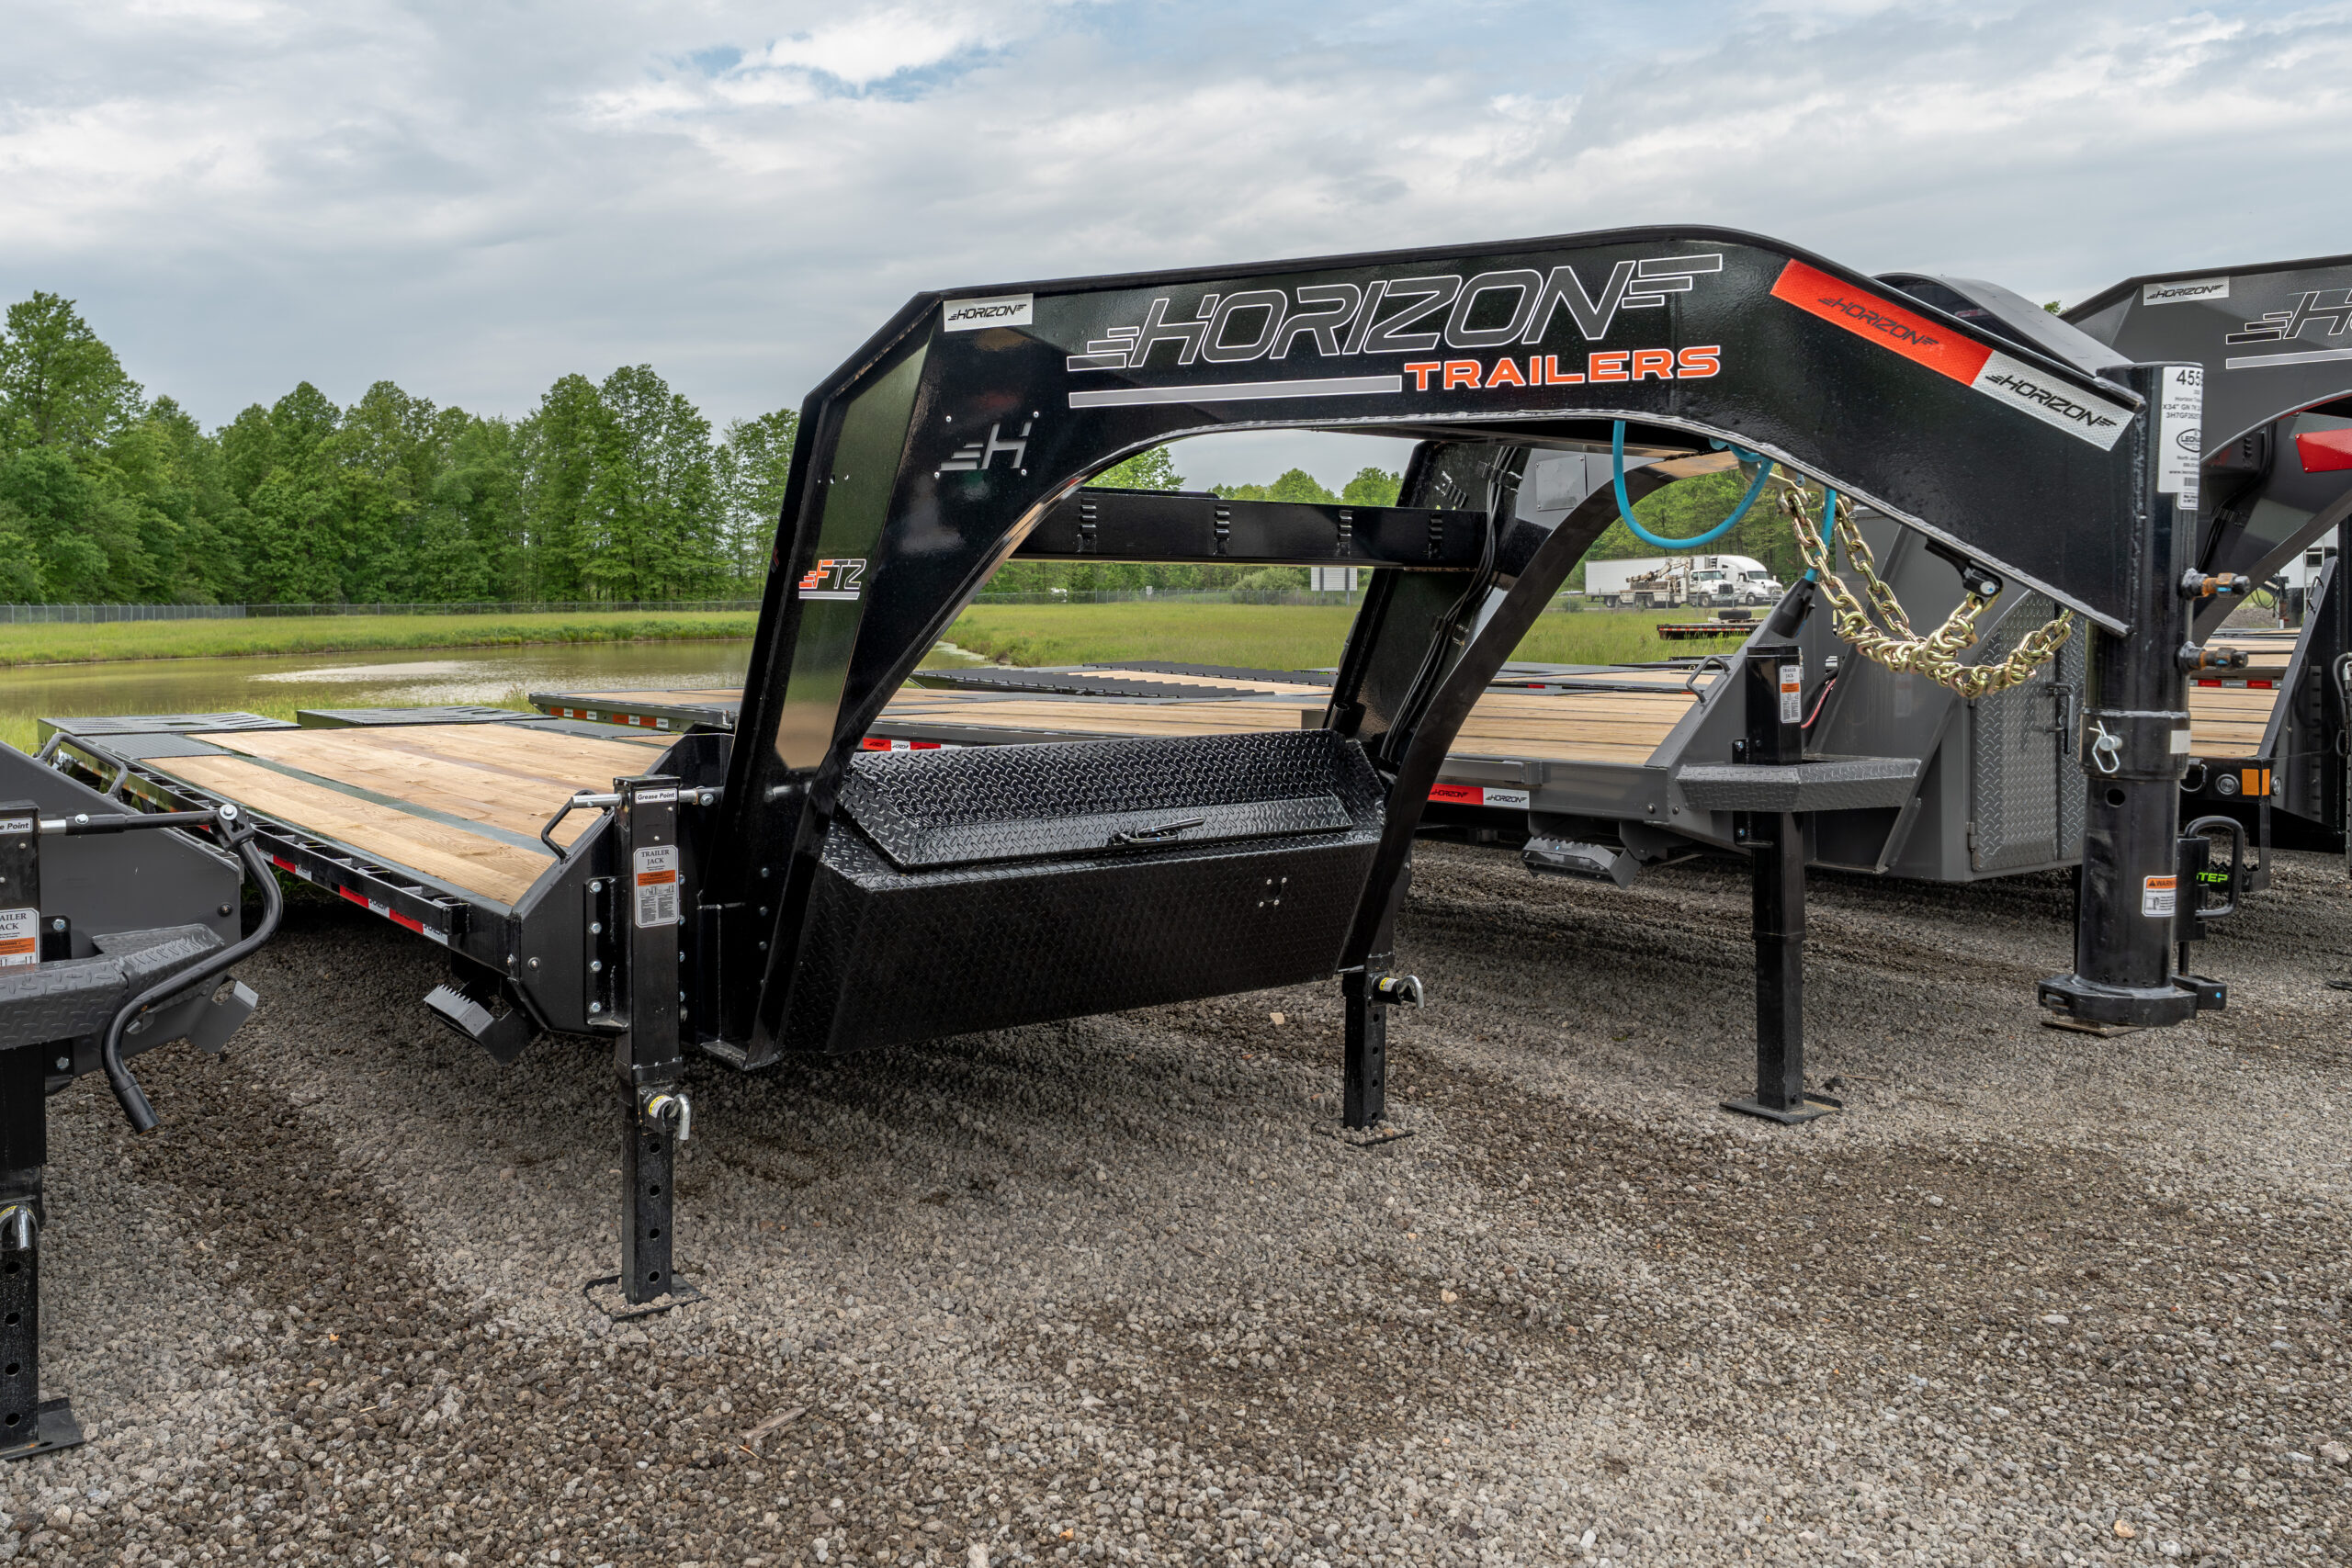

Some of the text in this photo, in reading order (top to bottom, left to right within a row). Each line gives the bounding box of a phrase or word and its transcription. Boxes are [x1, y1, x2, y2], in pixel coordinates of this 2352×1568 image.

[2155, 285, 2217, 299] HORIZON
[956, 304, 1018, 321] HORIZON
[1128, 259, 1636, 368] HORIZON
[1831, 297, 1928, 346] HORIZON
[1403, 344, 1722, 392] TRAILERS
[2176, 369, 2203, 387] 455
[2003, 374, 2105, 428] HORIZON
[1433, 788, 1465, 798] HORIZON
[1489, 795, 1522, 804] HORIZON
[6, 822, 29, 830] Point
[641, 849, 670, 858] TRAILER
[647, 857, 665, 866] JACK
[0, 912, 28, 922] AILER
[0, 922, 19, 931] ACK
